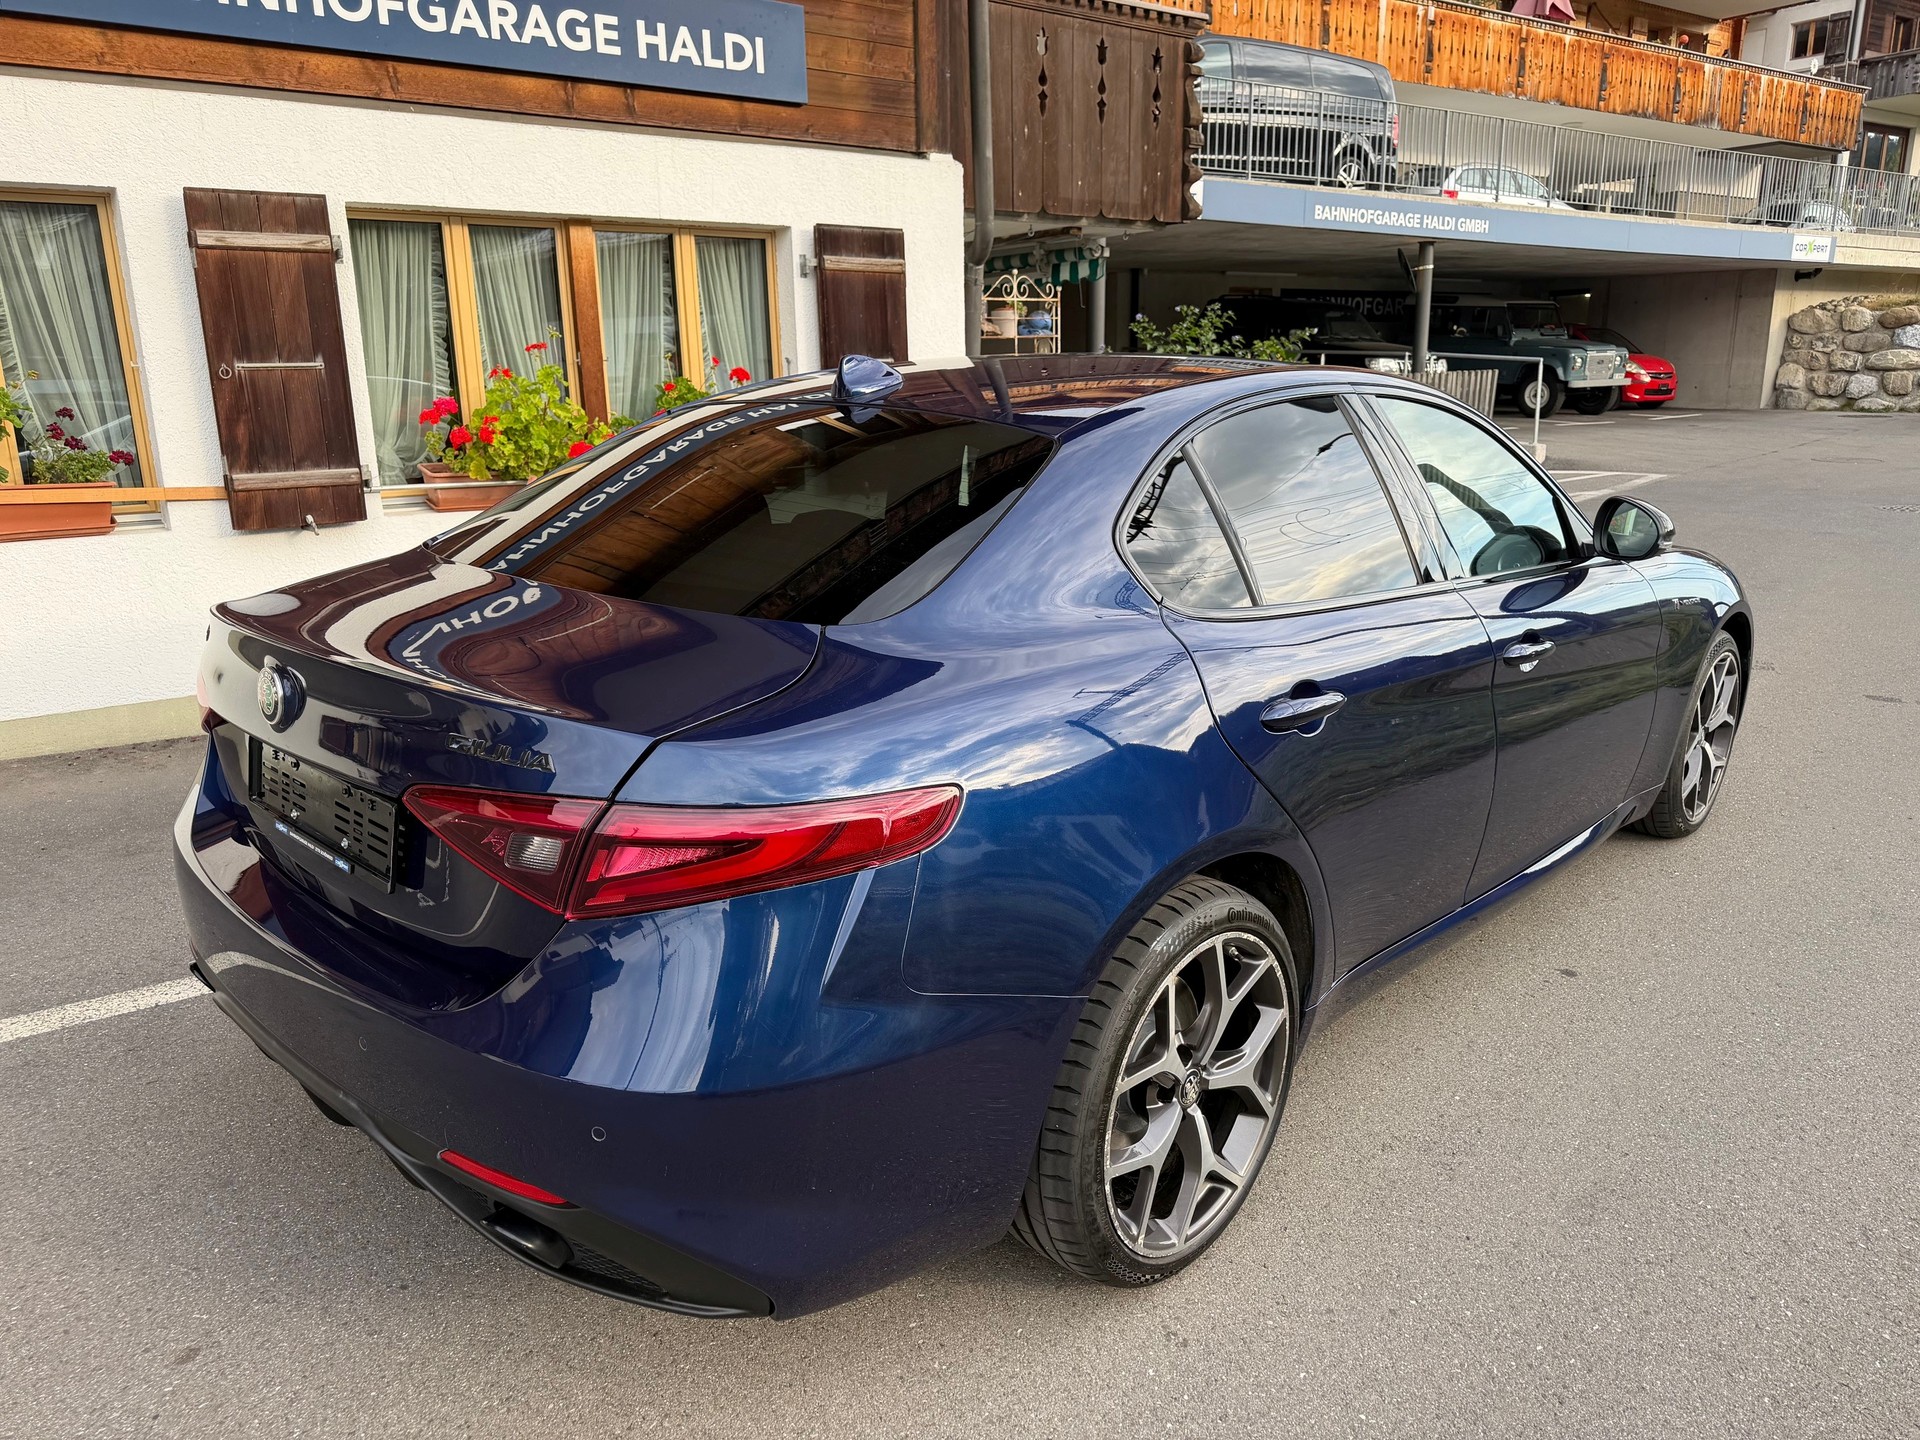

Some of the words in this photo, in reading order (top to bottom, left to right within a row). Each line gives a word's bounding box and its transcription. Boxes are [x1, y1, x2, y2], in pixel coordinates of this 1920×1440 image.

[636, 19, 765, 74] HALDI
[1314, 204, 1421, 229] BAHNHOFGARAGE
[1423, 214, 1455, 231] HALDI
[1457, 217, 1489, 234] GMBH
[445, 732, 556, 773] GIULIA
[1227, 906, 1271, 932] Continental
